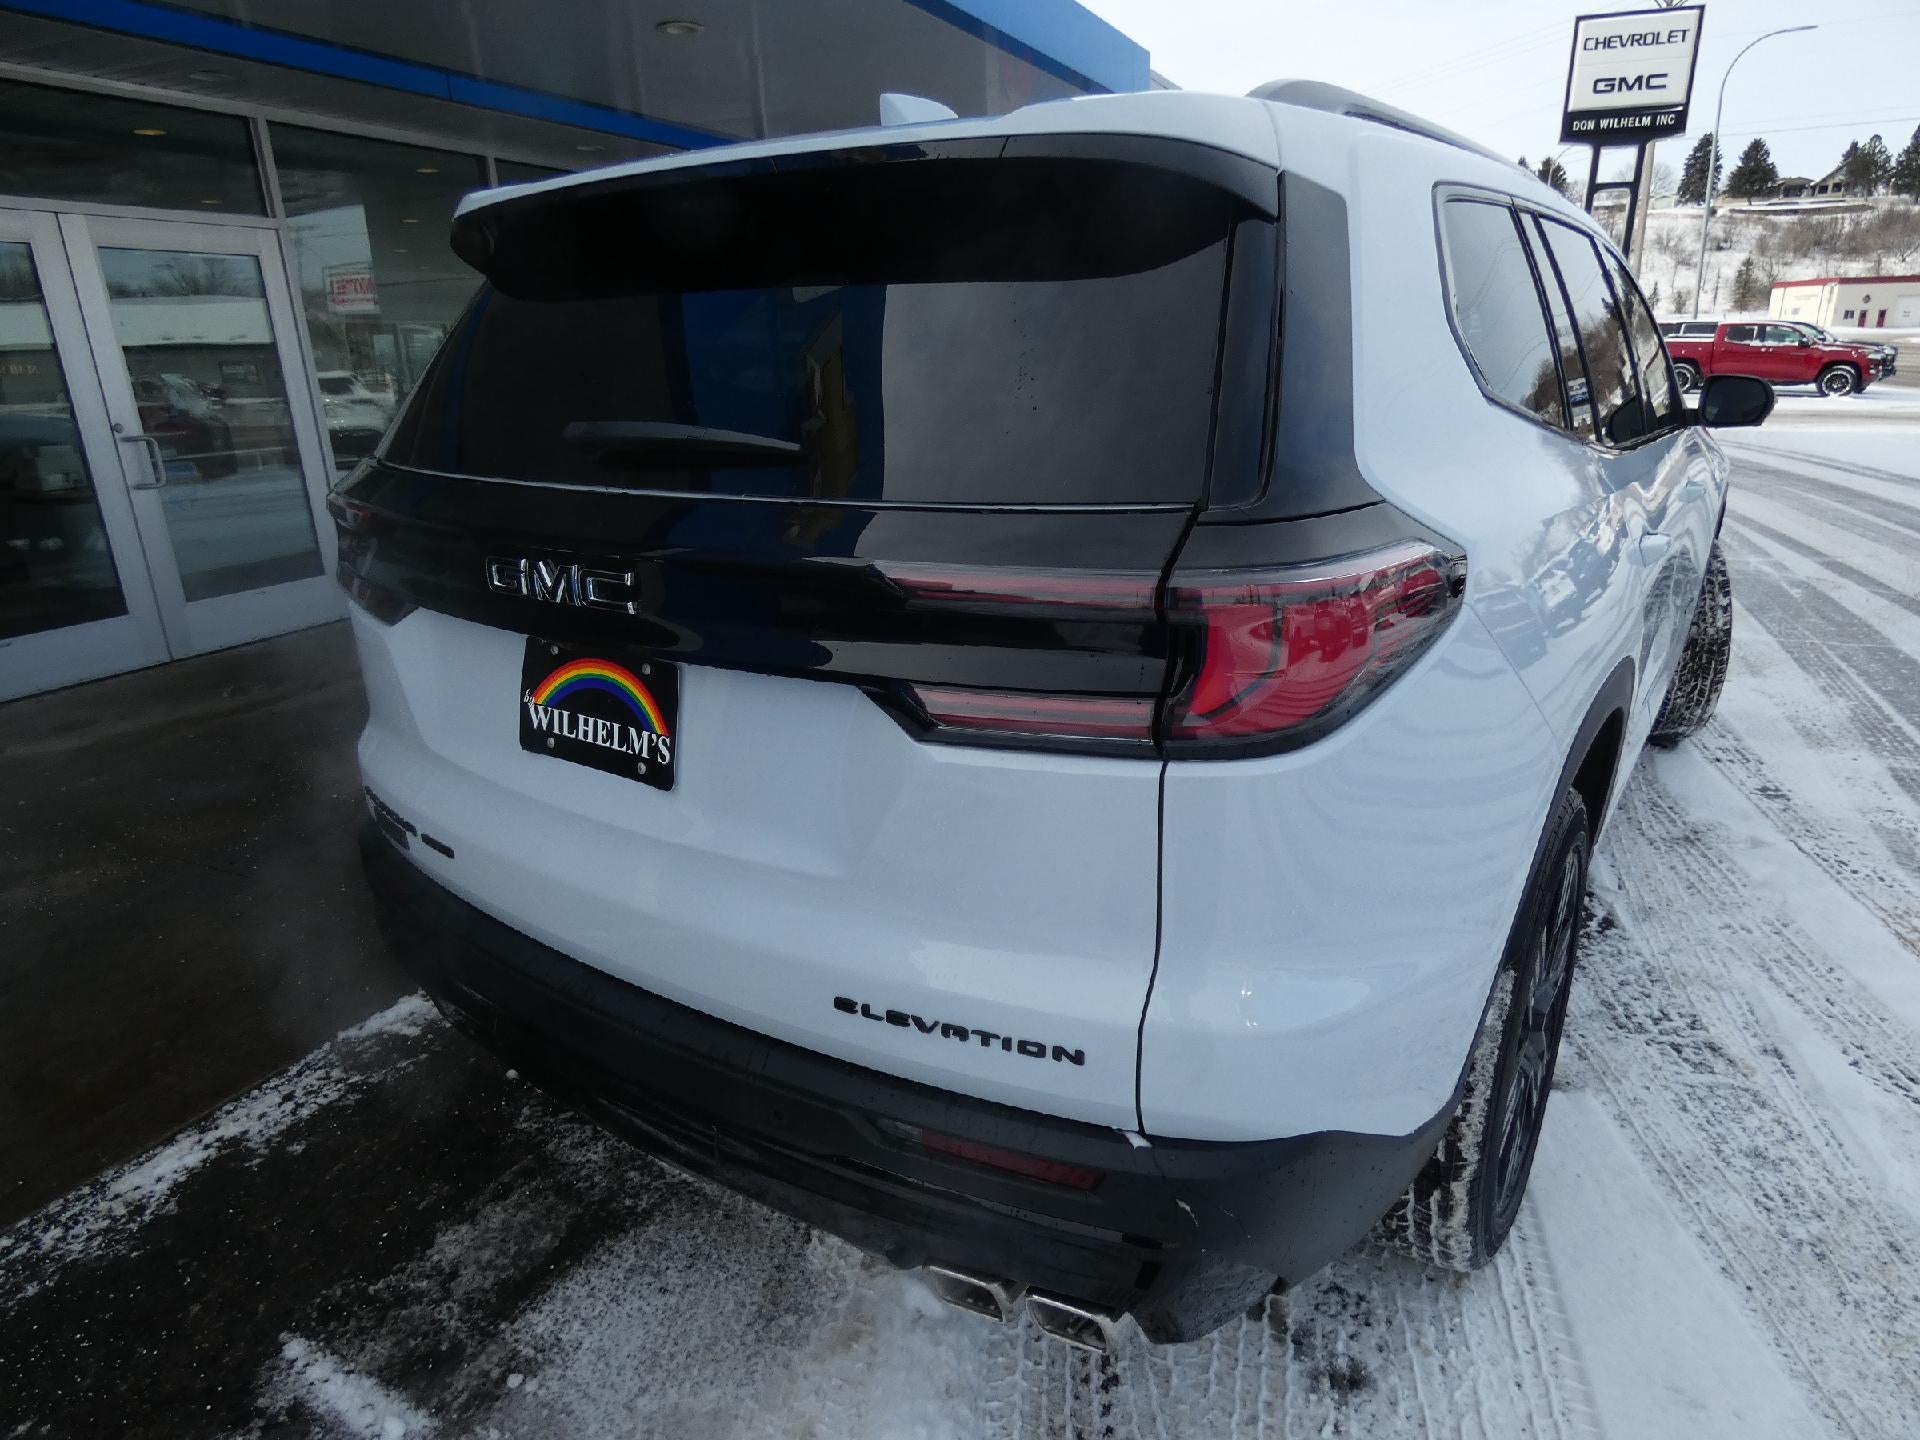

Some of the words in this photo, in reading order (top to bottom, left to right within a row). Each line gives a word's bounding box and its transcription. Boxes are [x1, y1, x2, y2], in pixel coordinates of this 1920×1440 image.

[1583, 28, 1690, 51] CHEVROLET
[1593, 73, 1668, 94] GMC
[1572, 120, 1595, 131] DON
[1599, 115, 1652, 129] WILHELM
[1656, 114, 1676, 125] INC
[486, 555, 638, 615] GMC
[528, 703, 672, 766] WILHELM'S
[833, 995, 1086, 1066] ELEVATION
